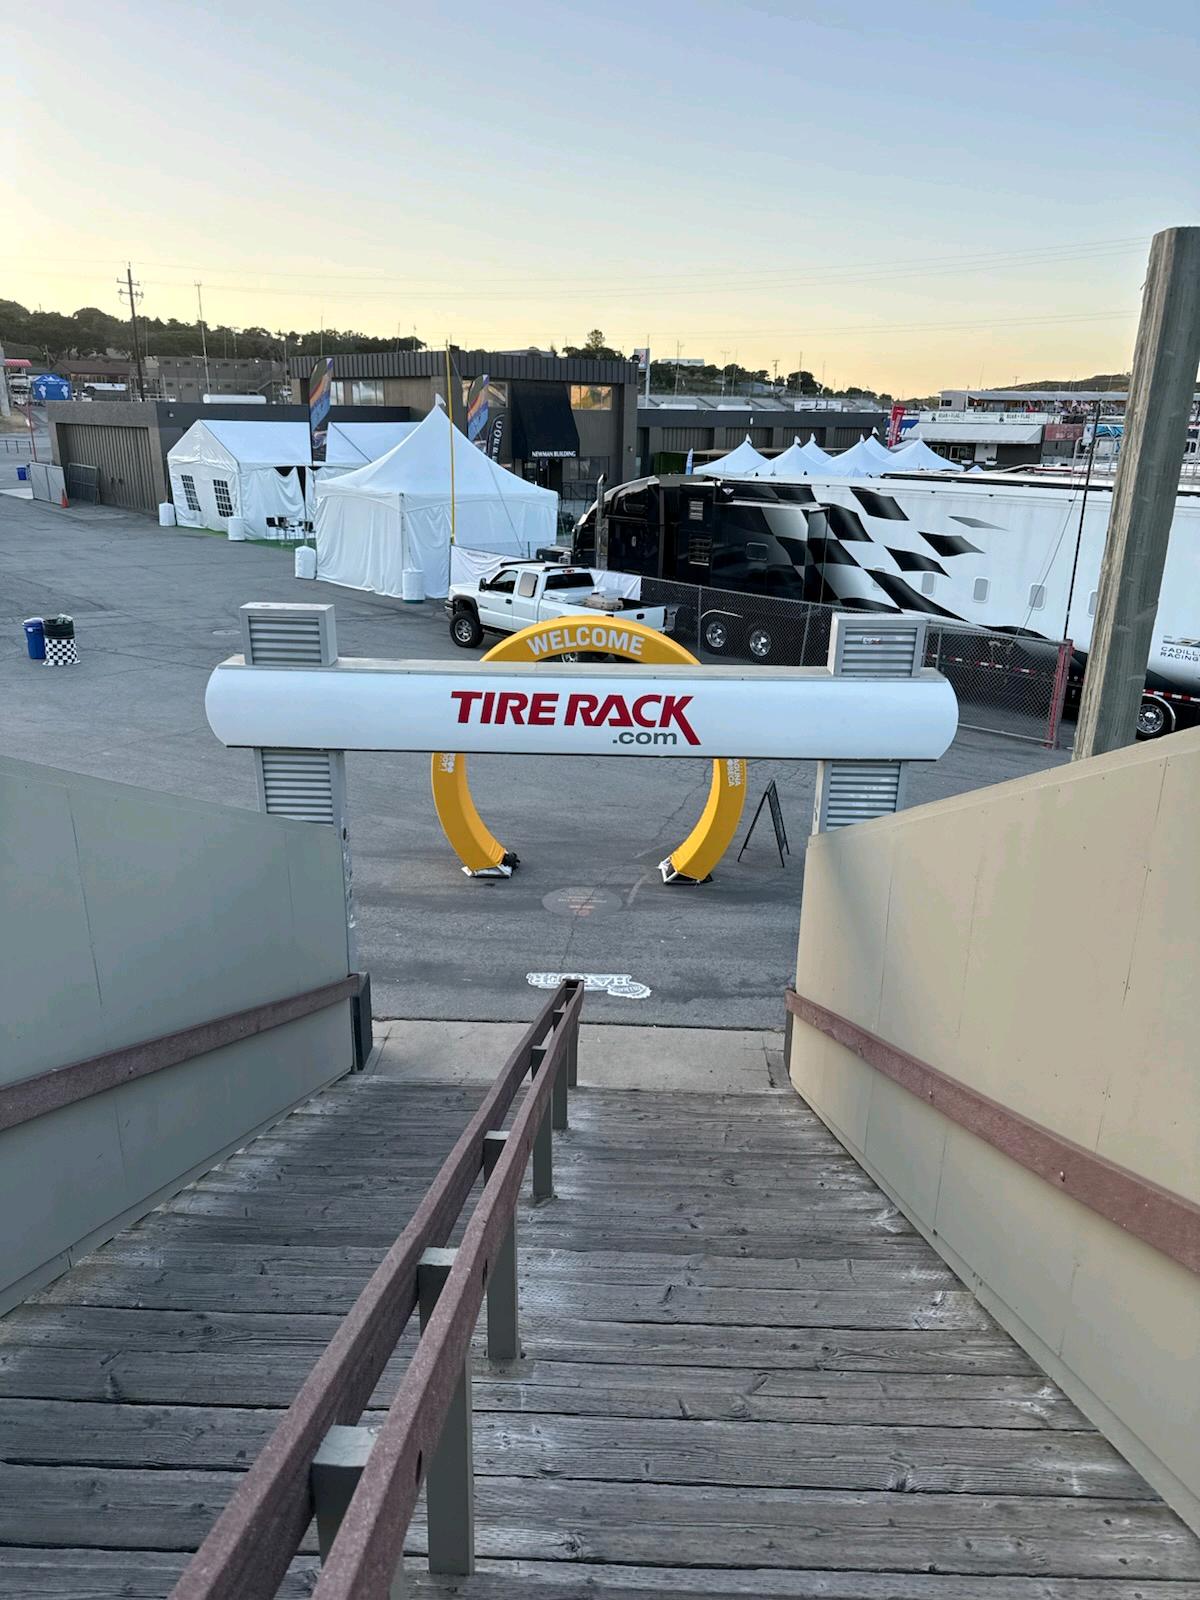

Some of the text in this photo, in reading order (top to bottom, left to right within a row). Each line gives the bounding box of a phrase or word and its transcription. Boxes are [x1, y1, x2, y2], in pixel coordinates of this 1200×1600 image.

[526, 626, 645, 656] WELCOME
[1160, 651, 1199, 662] RACING
[1161, 646, 1200, 657] CADILL
[451, 691, 702, 745] TIRE RACK
[612, 731, 678, 745] .com
